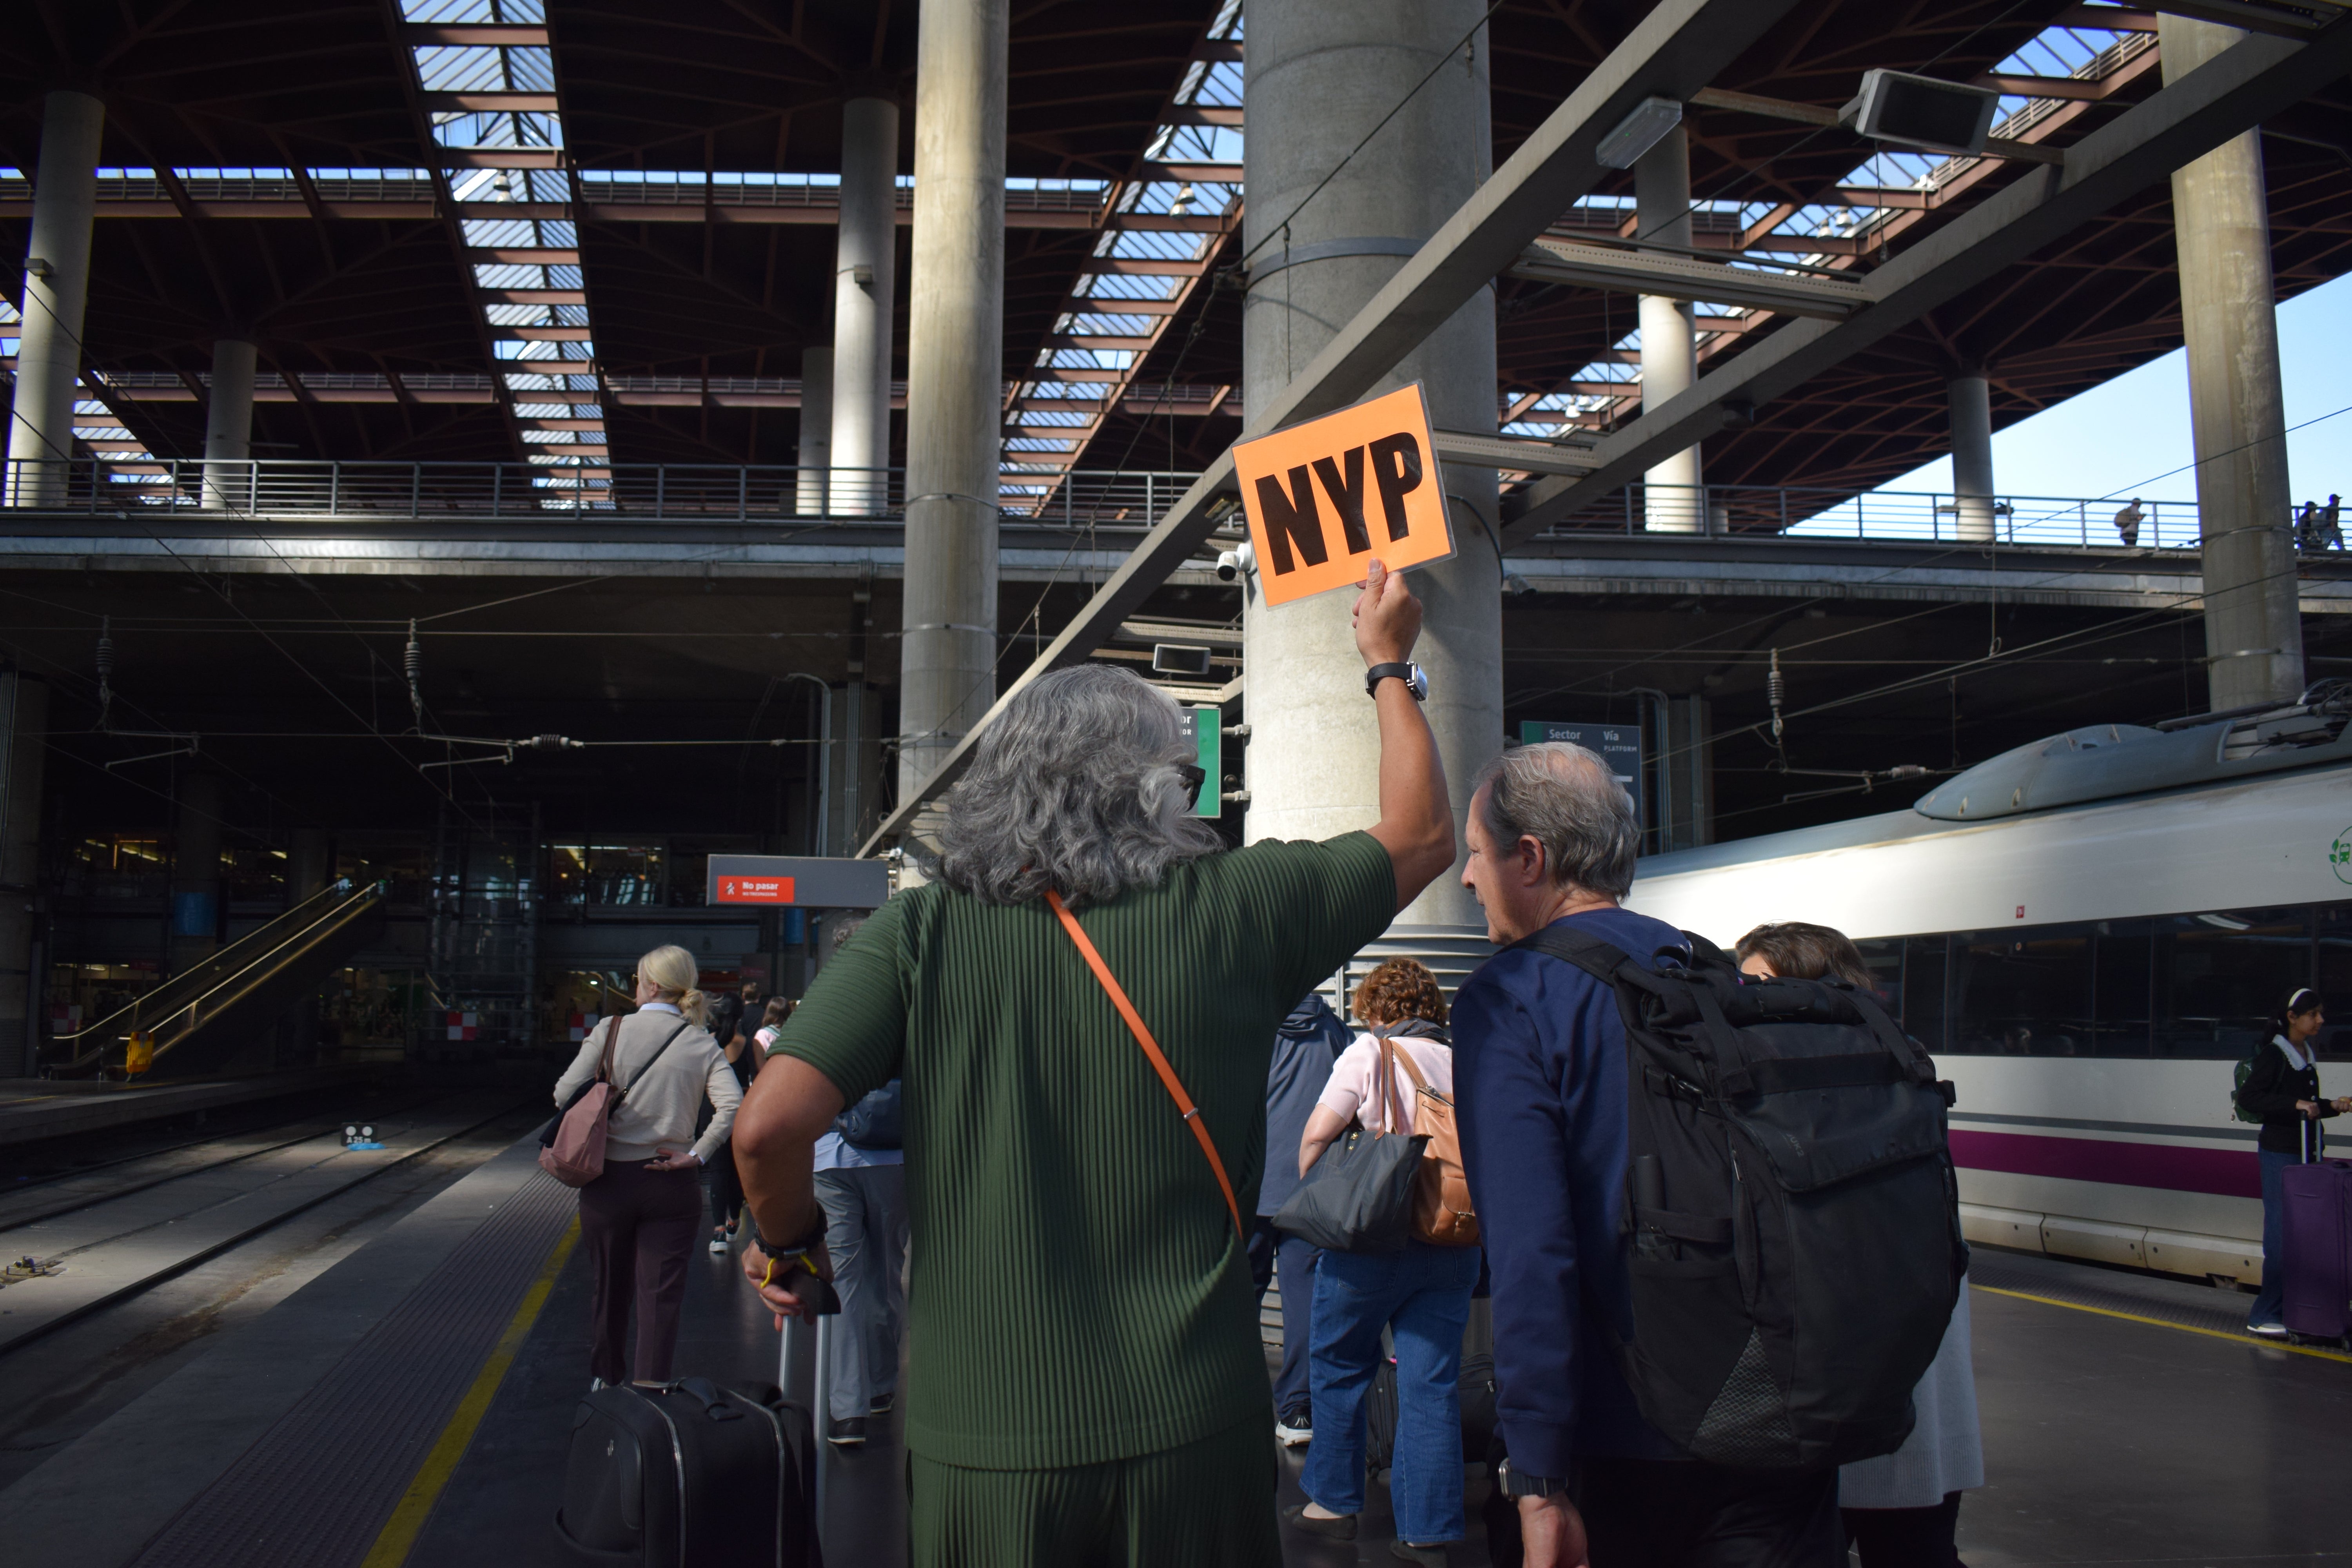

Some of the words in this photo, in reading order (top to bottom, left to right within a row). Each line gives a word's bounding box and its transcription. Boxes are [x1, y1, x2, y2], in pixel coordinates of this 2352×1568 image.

[1254, 432, 1423, 576] NYP
[1549, 729, 1581, 739] Sector
[1603, 730, 1619, 741] Vía
